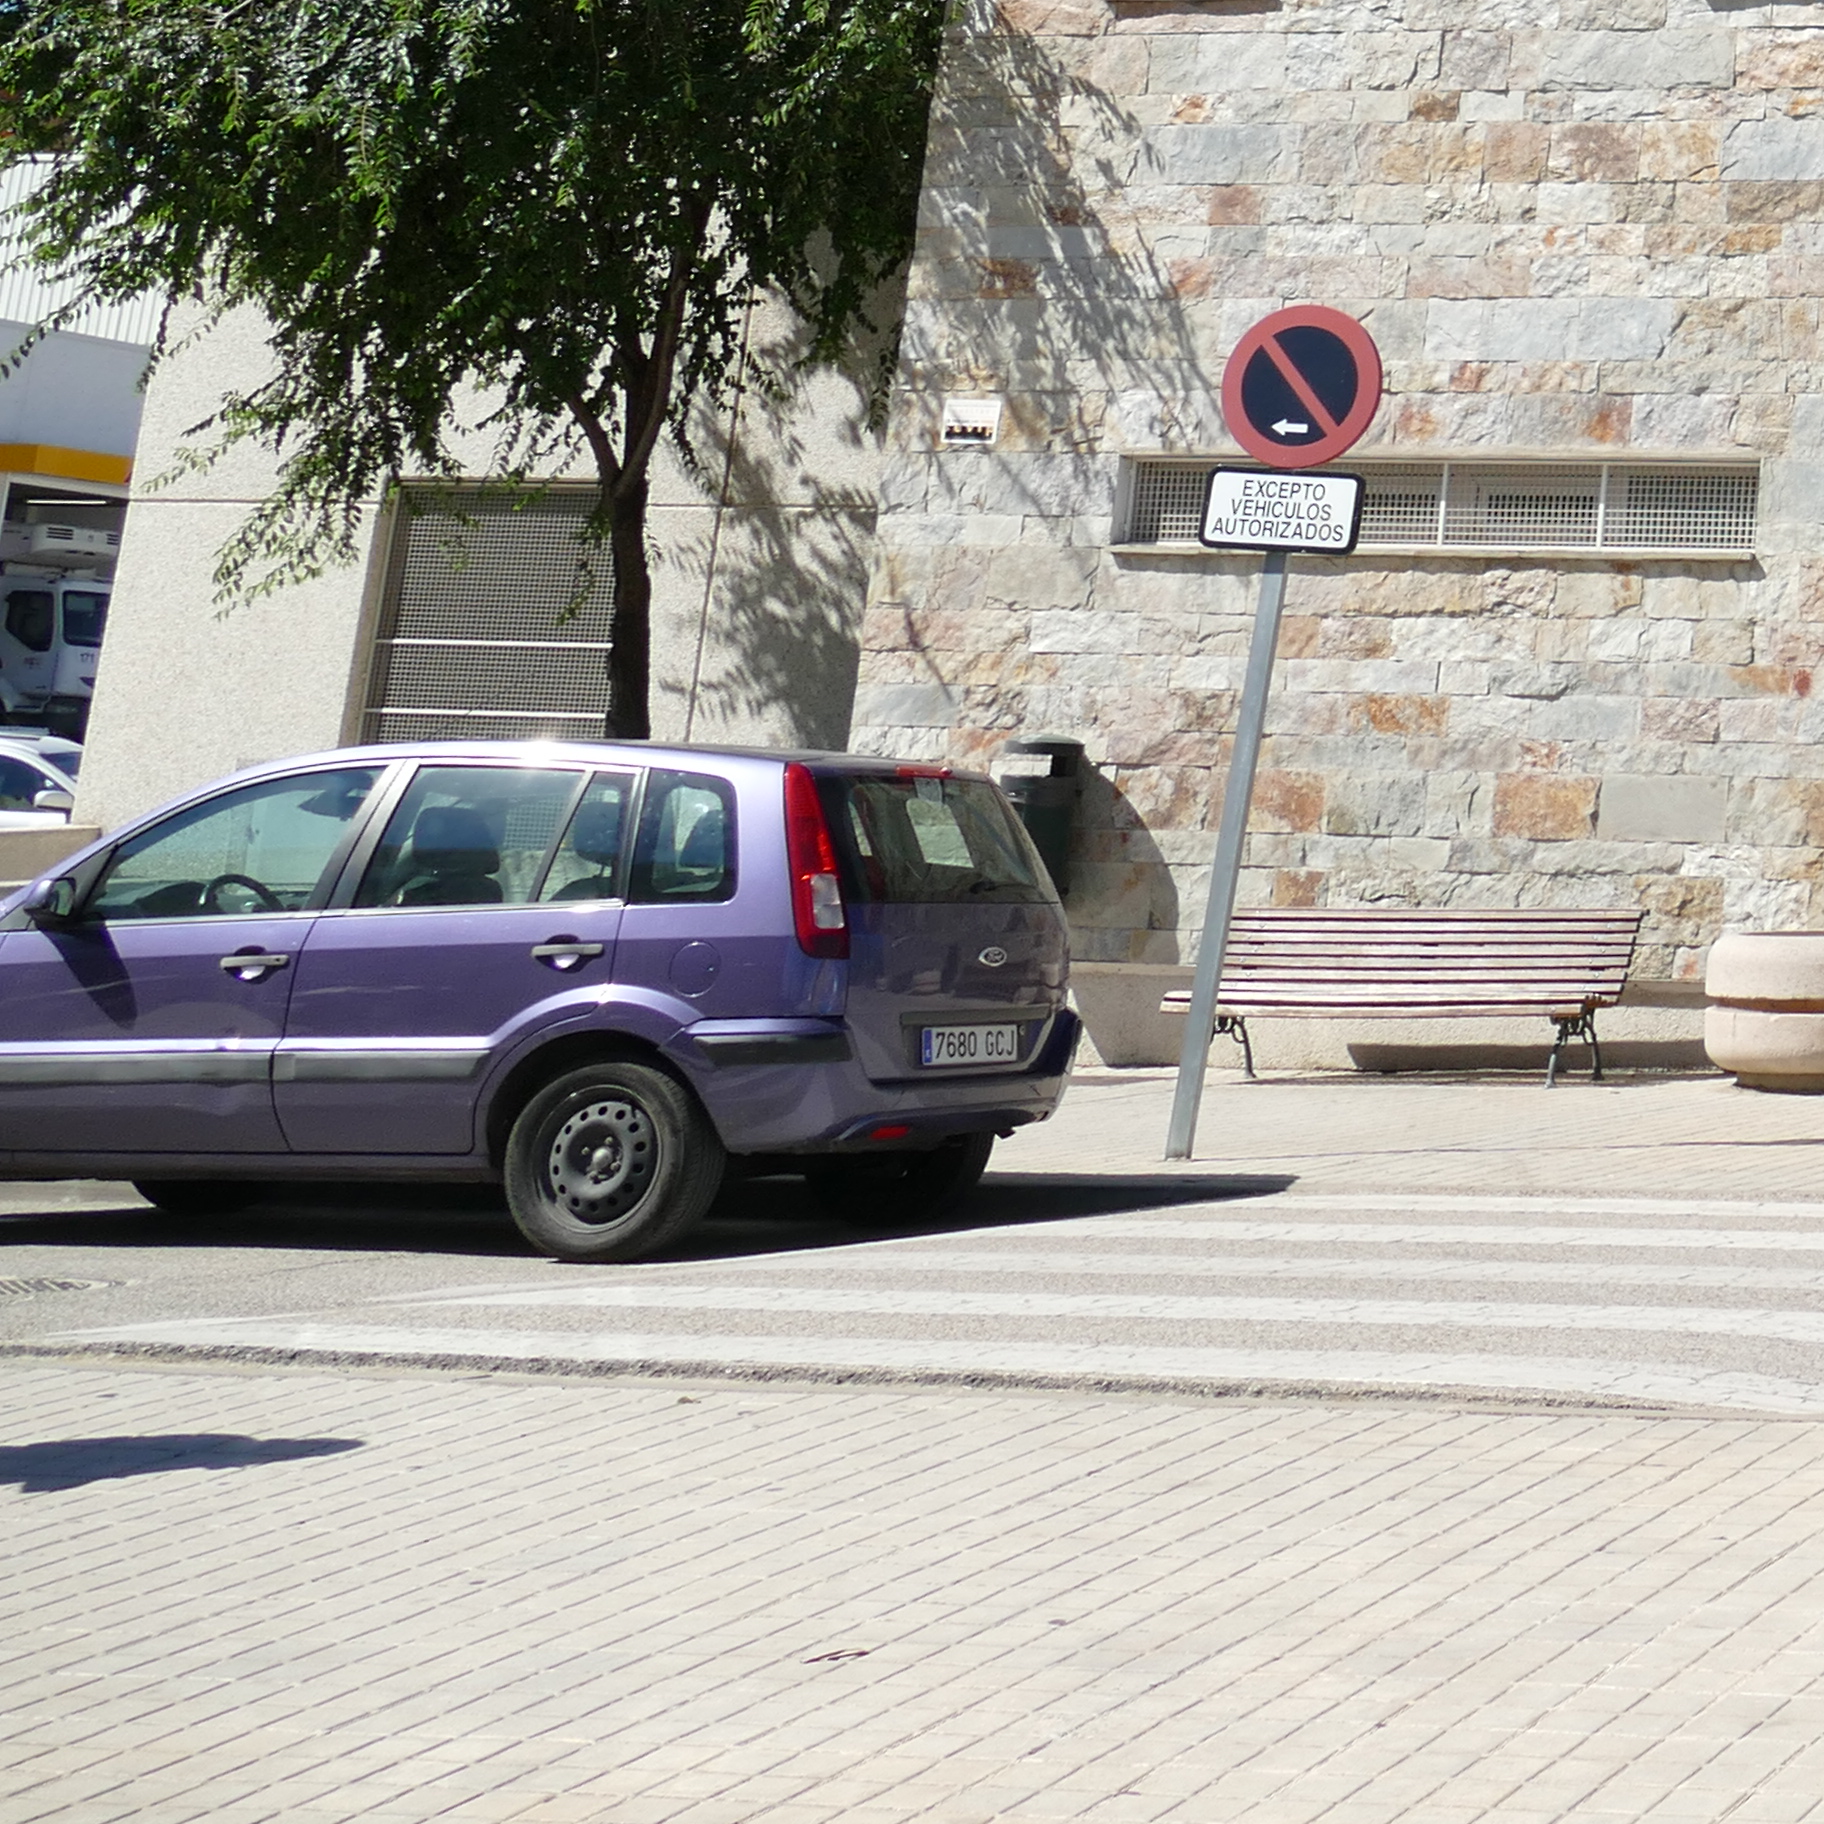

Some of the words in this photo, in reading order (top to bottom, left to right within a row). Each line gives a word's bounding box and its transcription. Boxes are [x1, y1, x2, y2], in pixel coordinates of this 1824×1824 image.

[1242, 479, 1326, 501] EXCEPTO
[1231, 498, 1333, 521] VEHICULOS
[1211, 517, 1345, 542] AUTORIZADOS
[935, 1030, 978, 1060] 7680
[985, 1030, 1015, 1057] GCJ
